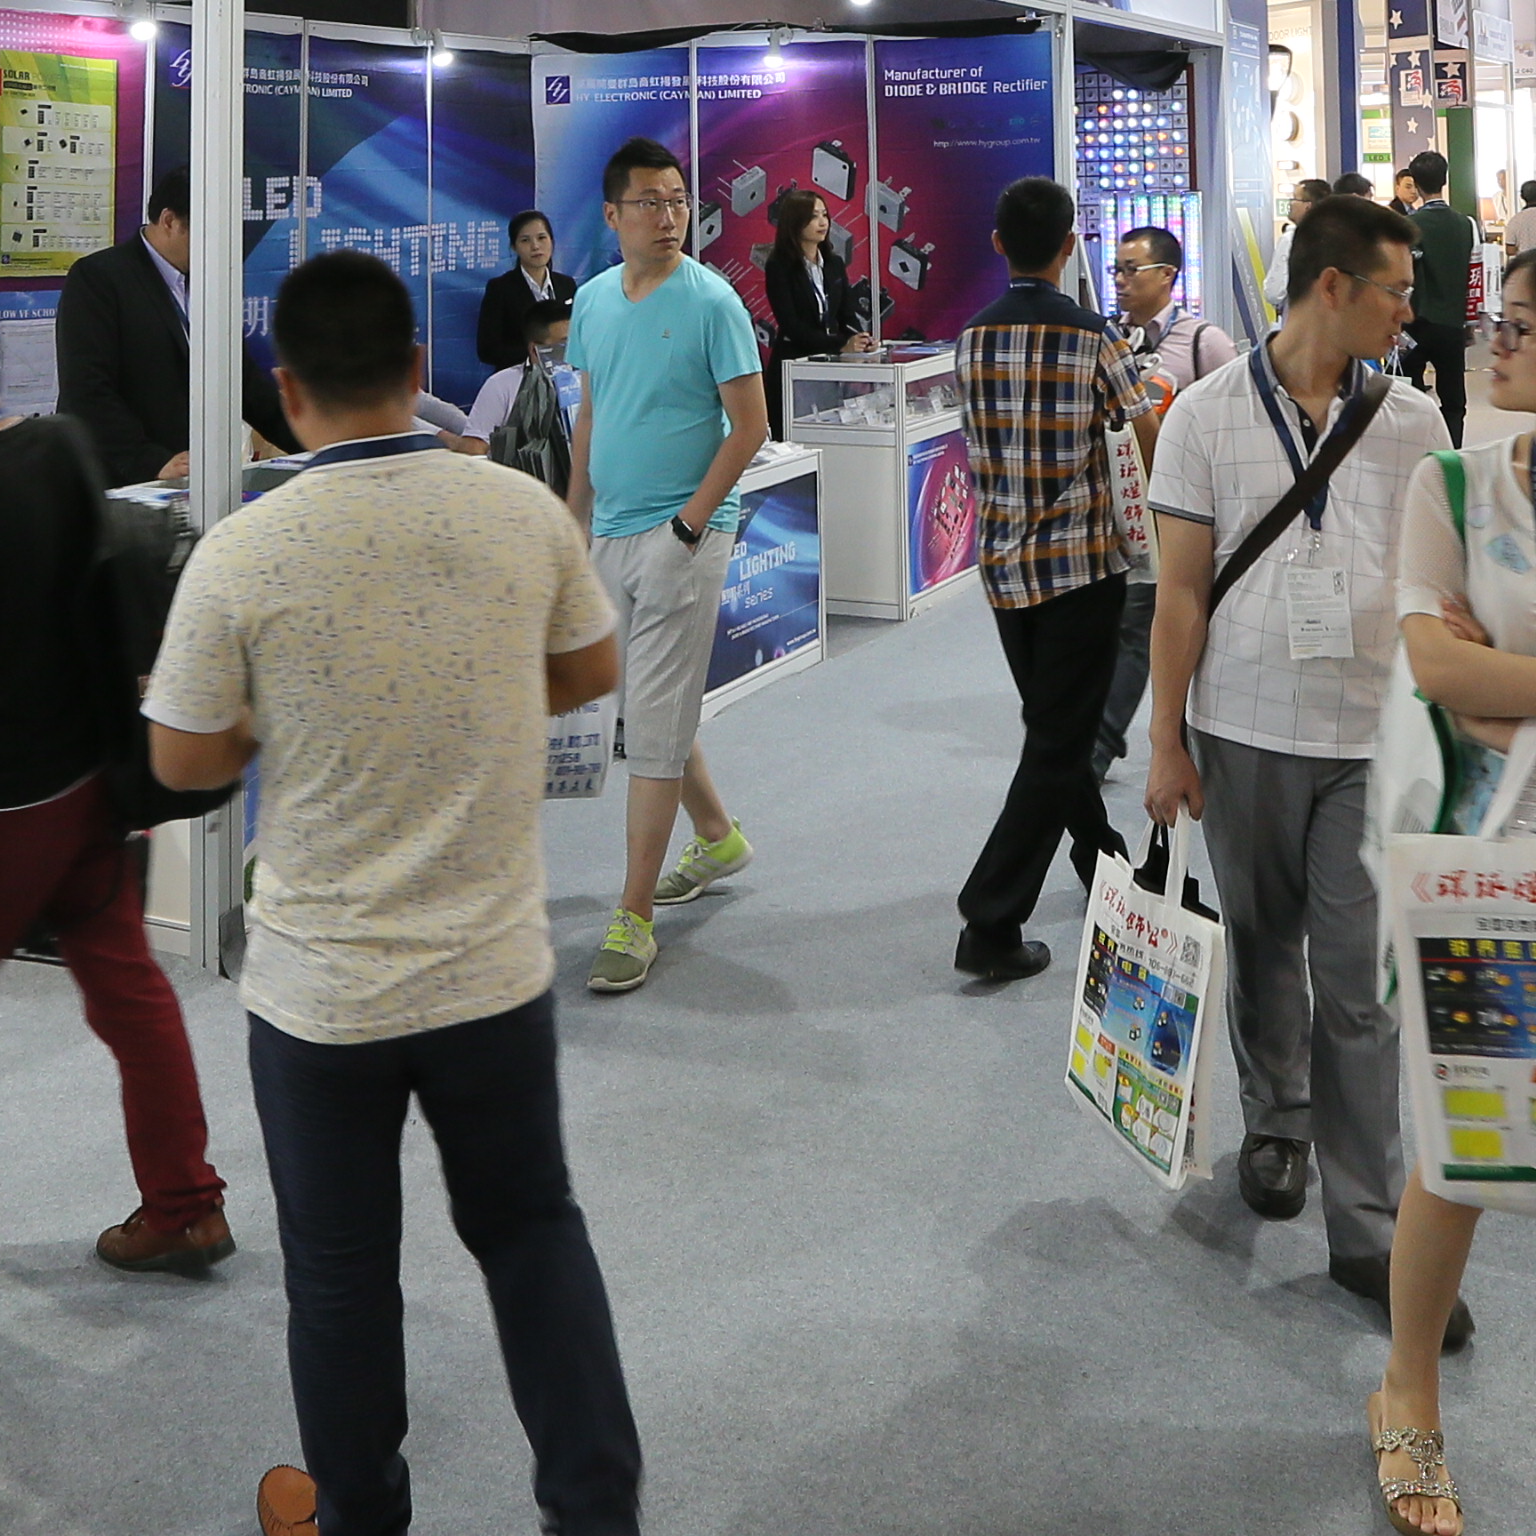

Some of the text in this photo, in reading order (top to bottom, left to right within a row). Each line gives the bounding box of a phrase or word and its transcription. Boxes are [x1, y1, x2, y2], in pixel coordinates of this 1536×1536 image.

[884, 65, 984, 82] Manufacturer of
[243, 83, 274, 96] TRONIC
[322, 87, 353, 98] LIMITED
[594, 89, 658, 103] ELECTRONIC
[718, 88, 762, 100] LIMITED
[884, 78, 1049, 97] DIODE & BRIDGE Rectifier
[243, 175, 323, 222] LED
[739, 540, 797, 582] LIGHTING
